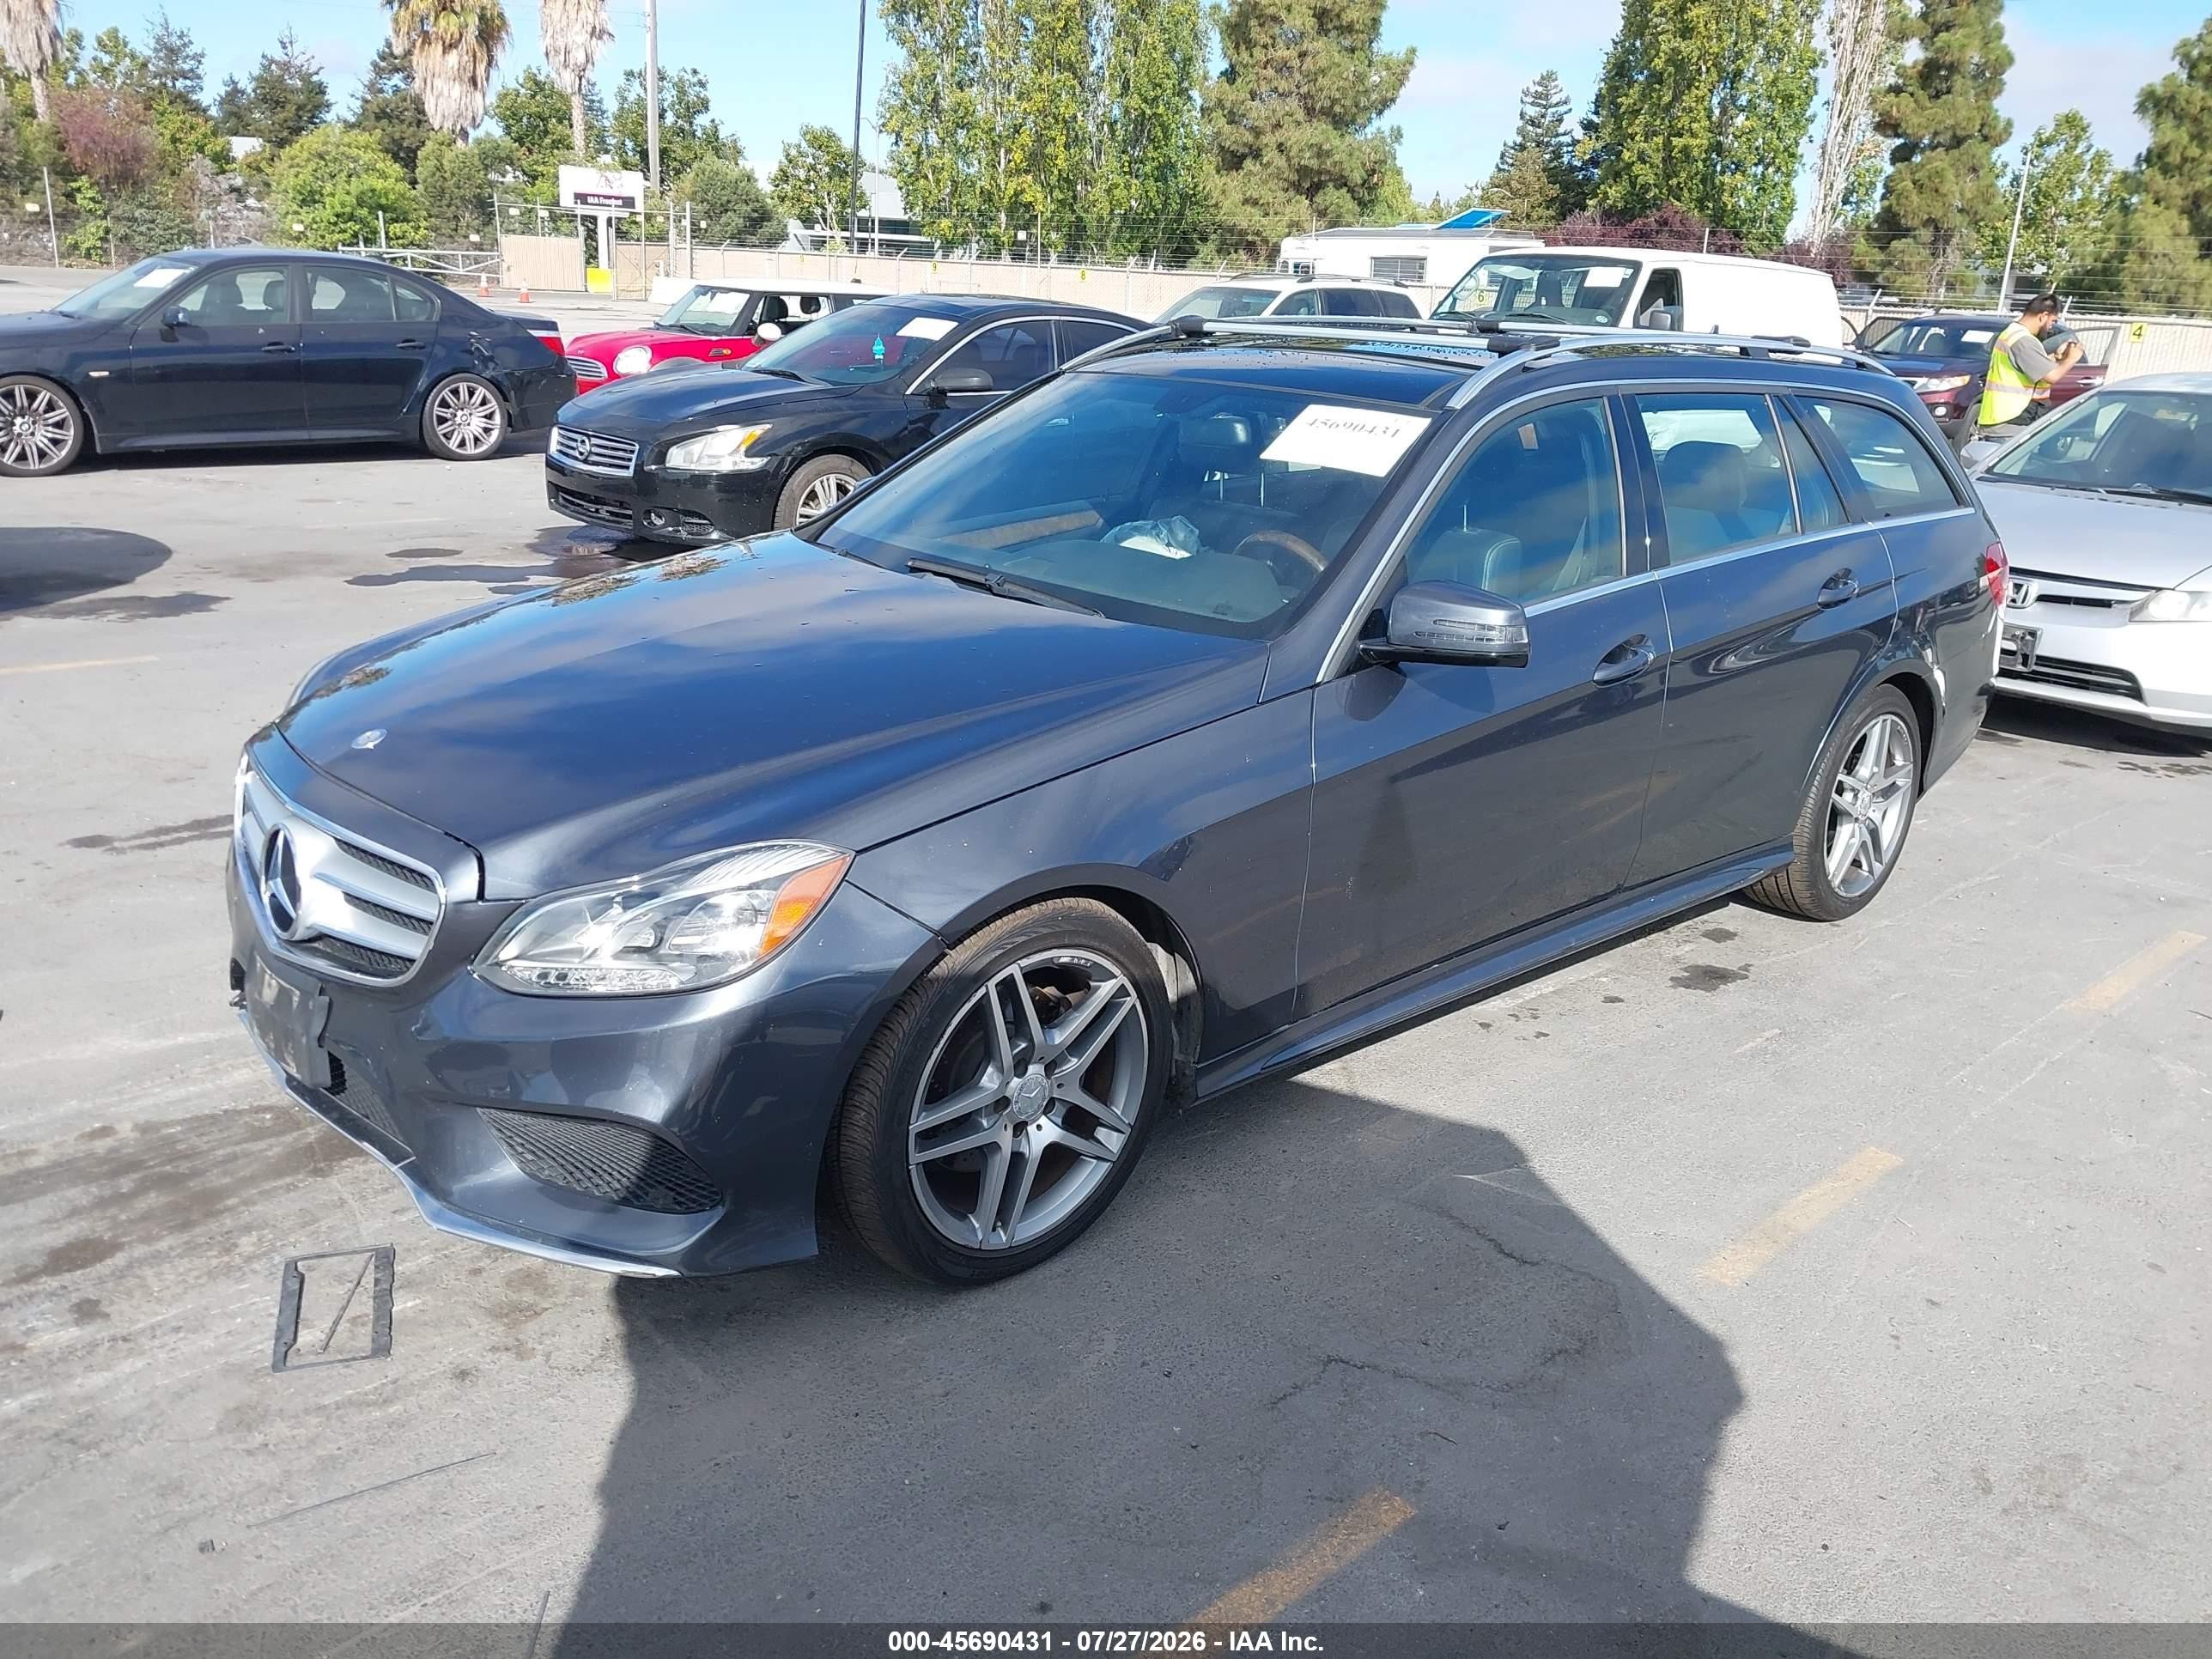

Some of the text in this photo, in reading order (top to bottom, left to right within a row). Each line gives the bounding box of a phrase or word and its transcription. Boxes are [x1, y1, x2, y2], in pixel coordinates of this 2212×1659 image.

[586, 195, 599, 204] IAA
[1080, 270, 1087, 281] 8
[1477, 290, 1485, 302] 6
[2132, 324, 2143, 339] 4
[1306, 417, 1401, 439] 45690431
